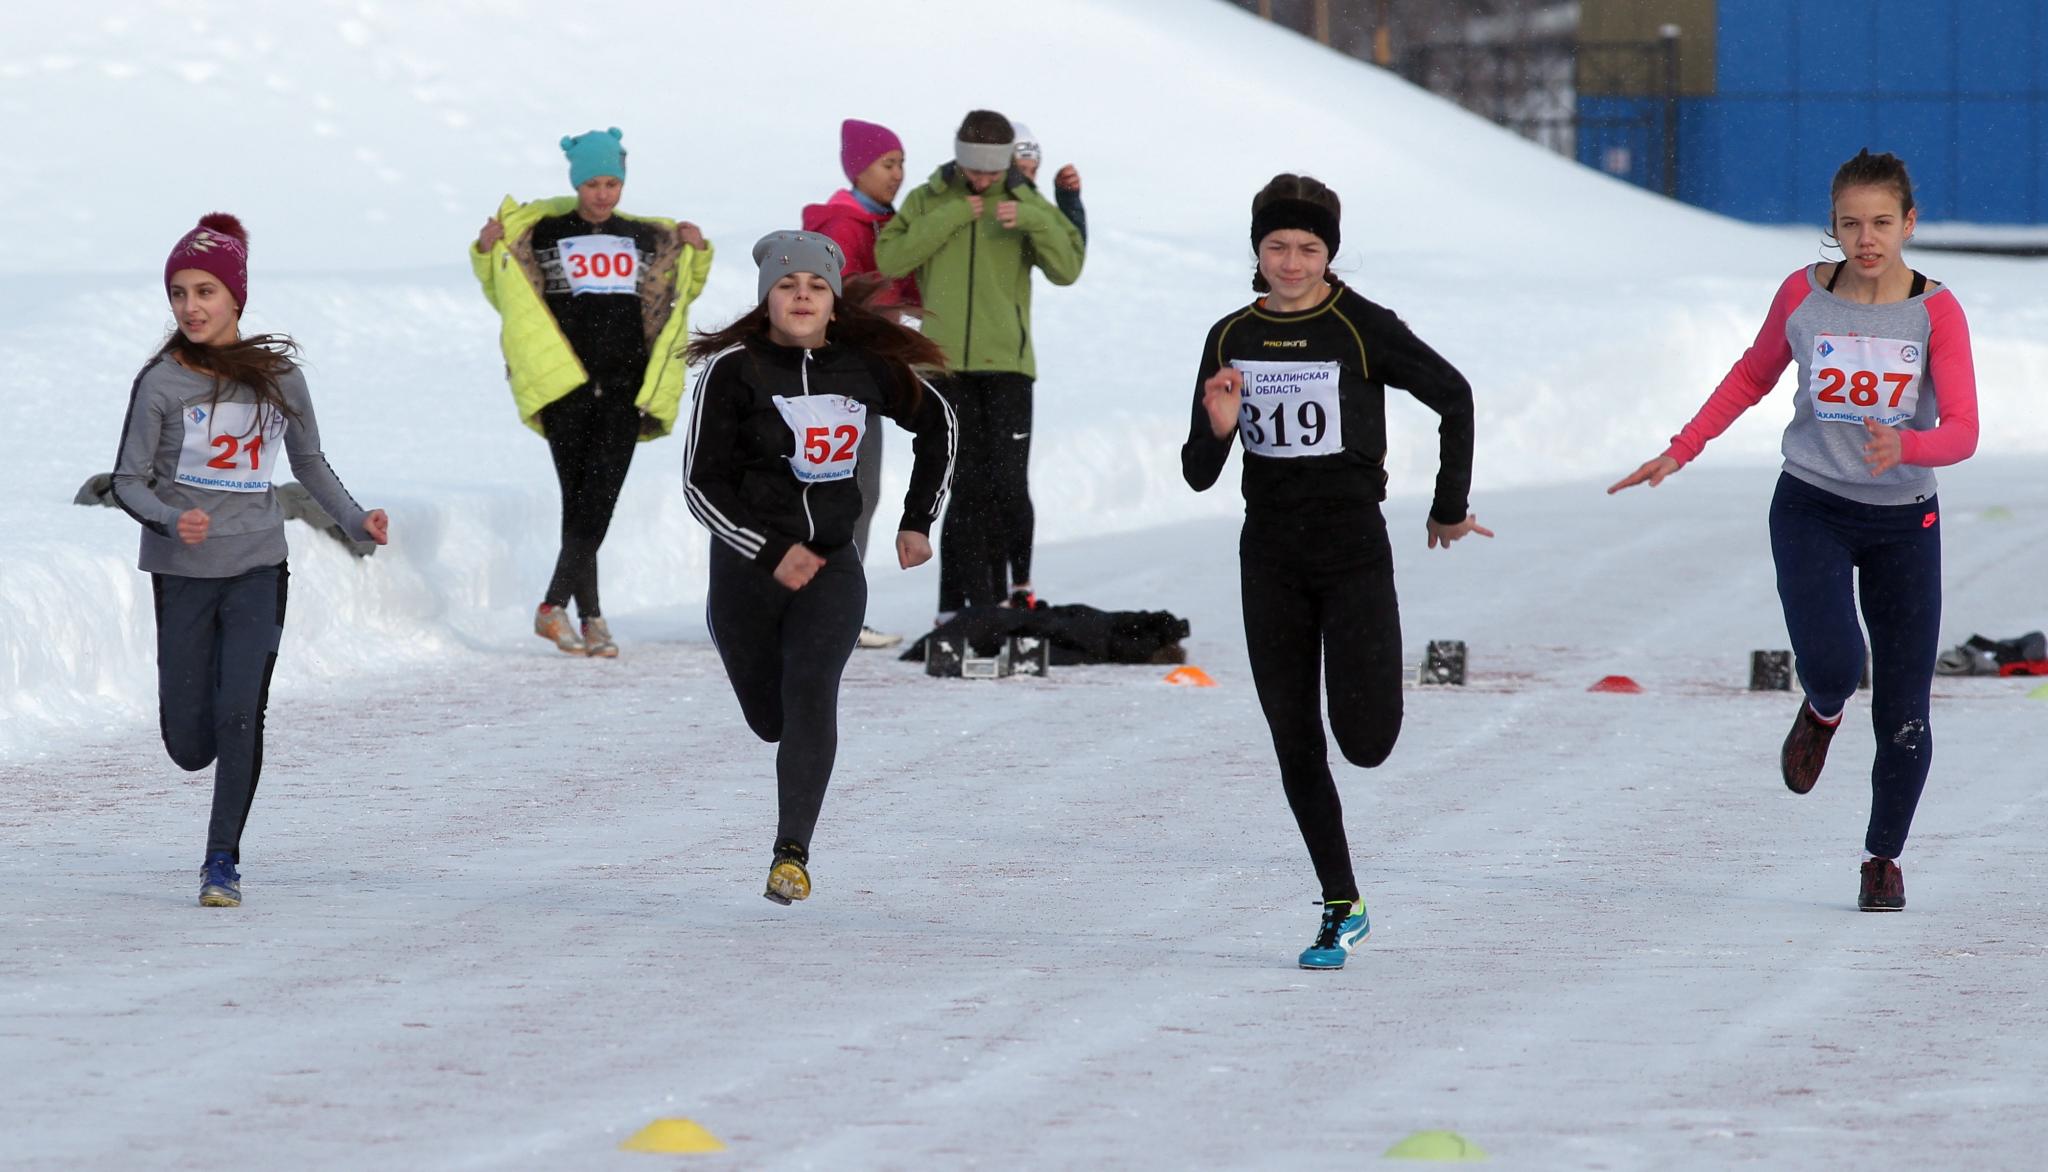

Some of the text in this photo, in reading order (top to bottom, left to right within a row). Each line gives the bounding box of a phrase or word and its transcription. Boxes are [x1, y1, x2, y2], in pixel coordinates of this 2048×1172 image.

[568, 253, 633, 278] 300
[1256, 372, 1329, 382] САХАЛИНСКАЯ
[1256, 385, 1301, 395] ОБЛАСТЬ
[1818, 368, 1913, 407] 287
[1242, 401, 1326, 446] 319
[206, 435, 261, 470] 21
[804, 425, 858, 464] 52
[180, 474, 242, 488] САХАЛИНСКАЯ
